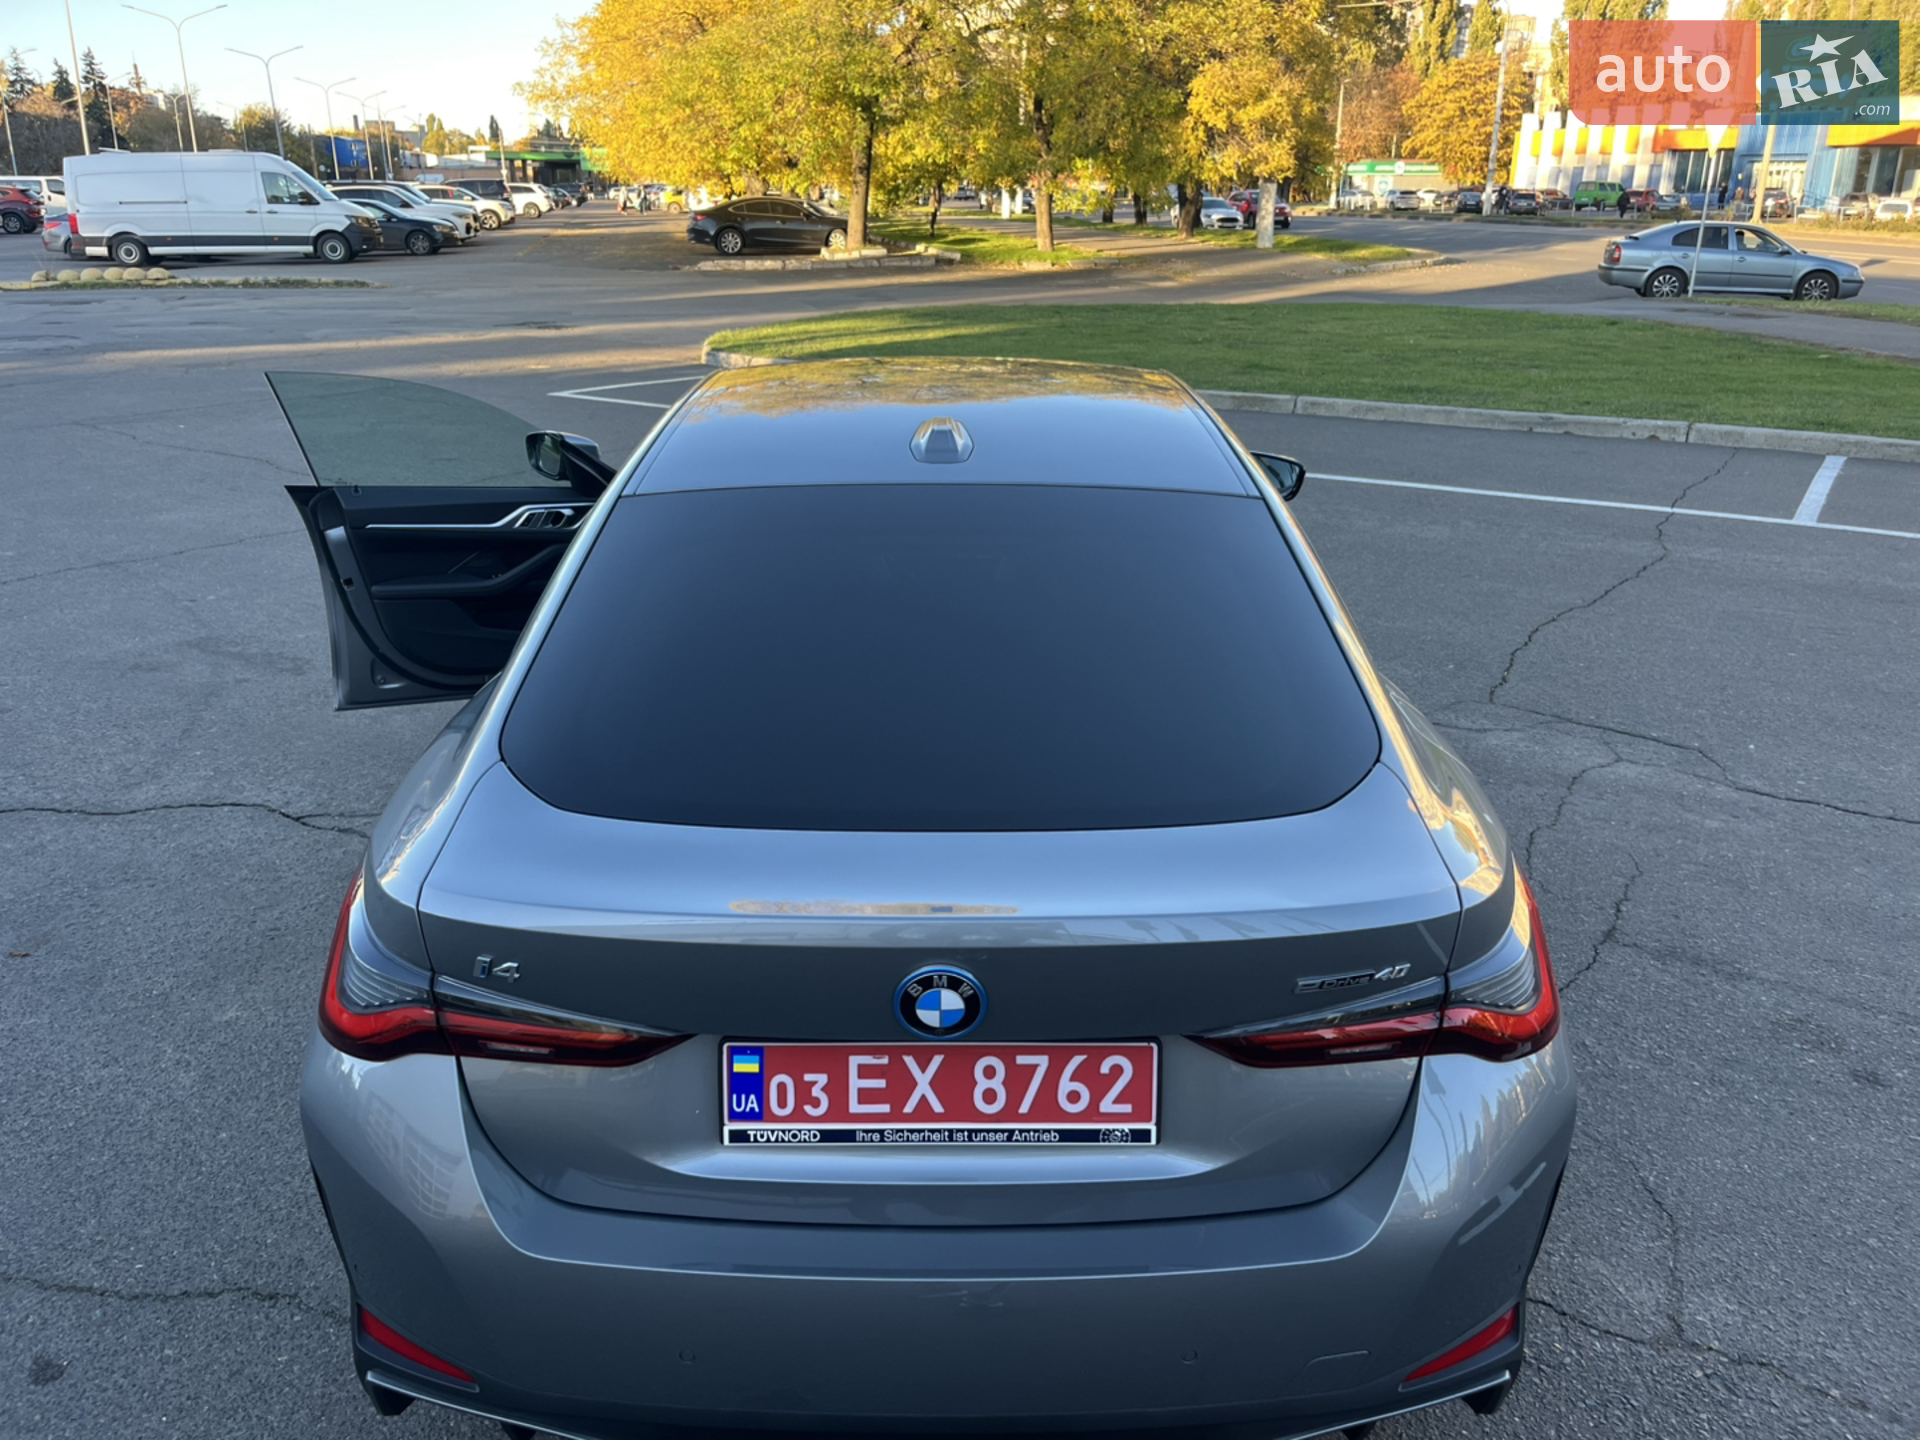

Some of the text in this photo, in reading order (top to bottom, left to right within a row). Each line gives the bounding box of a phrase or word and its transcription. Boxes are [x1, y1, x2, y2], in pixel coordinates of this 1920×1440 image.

[473, 954, 521, 984] i4
[906, 975, 974, 998] BMW
[769, 1055, 1134, 1117] 03 EX 8762
[732, 1093, 760, 1113] UA
[855, 1129, 881, 1143] Ihre
[883, 1129, 949, 1143] Sicherheit
[952, 1129, 969, 1143] ist
[972, 1131, 1008, 1143] unser
[1011, 1129, 1060, 1143] Antrieb
